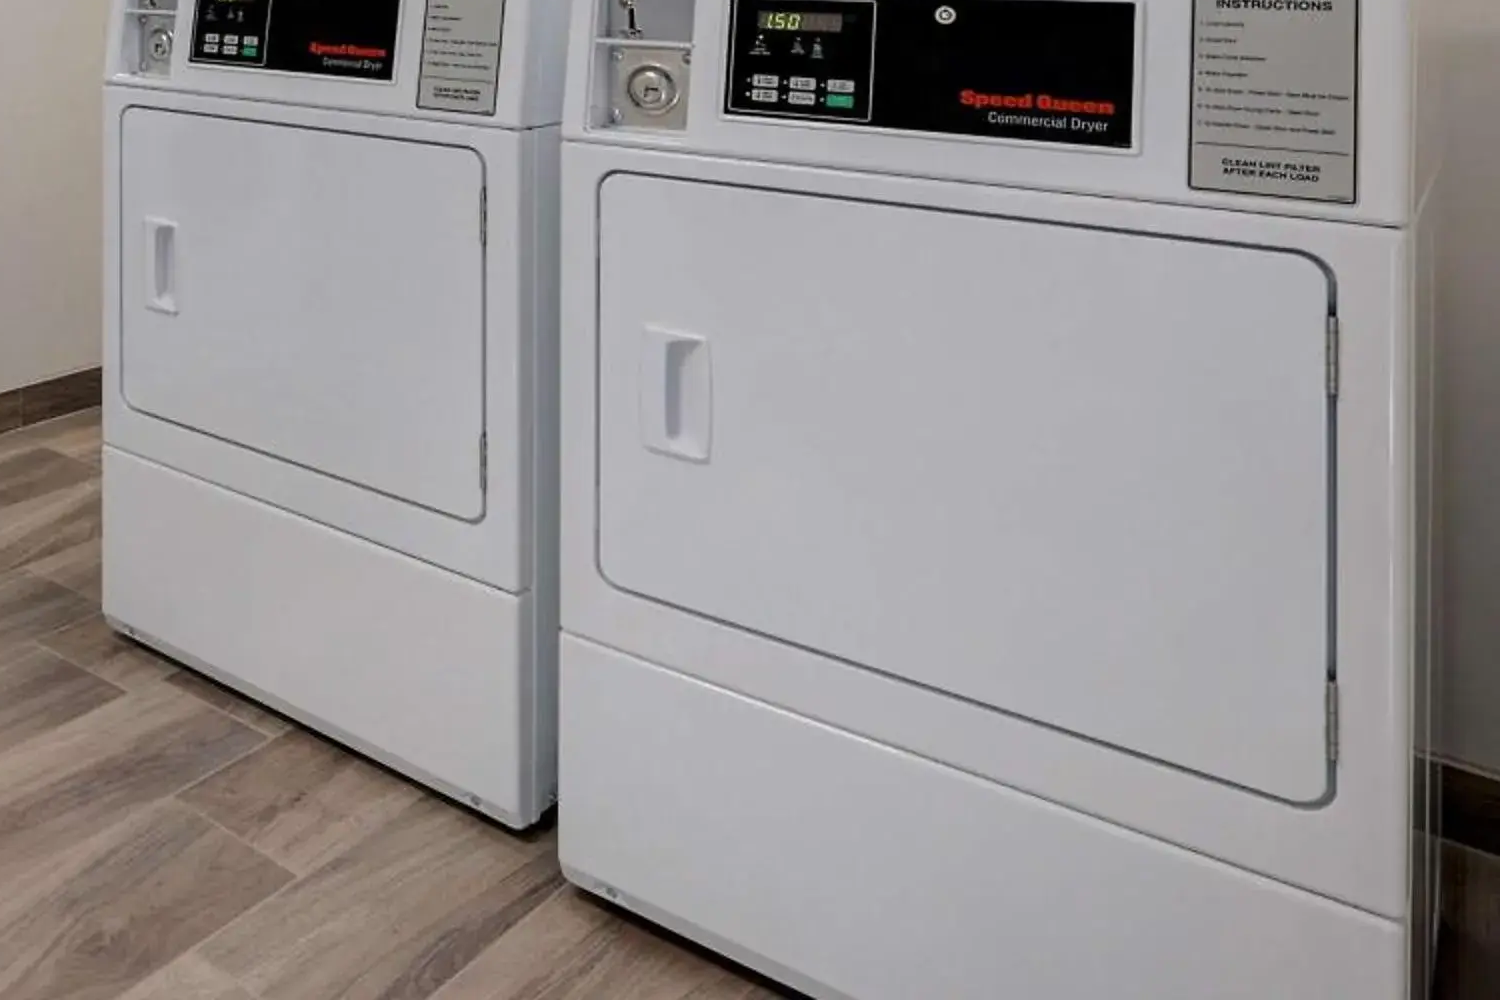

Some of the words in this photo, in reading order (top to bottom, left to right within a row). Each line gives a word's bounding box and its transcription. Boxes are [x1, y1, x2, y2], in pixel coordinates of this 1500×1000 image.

[1216, 0, 1333, 12] INSTRUCTIONS
[960, 89, 1032, 109] Speed
[1036, 94, 1115, 115] Queen
[987, 111, 1067, 129] Commercial
[1071, 117, 1108, 133] Dryer
